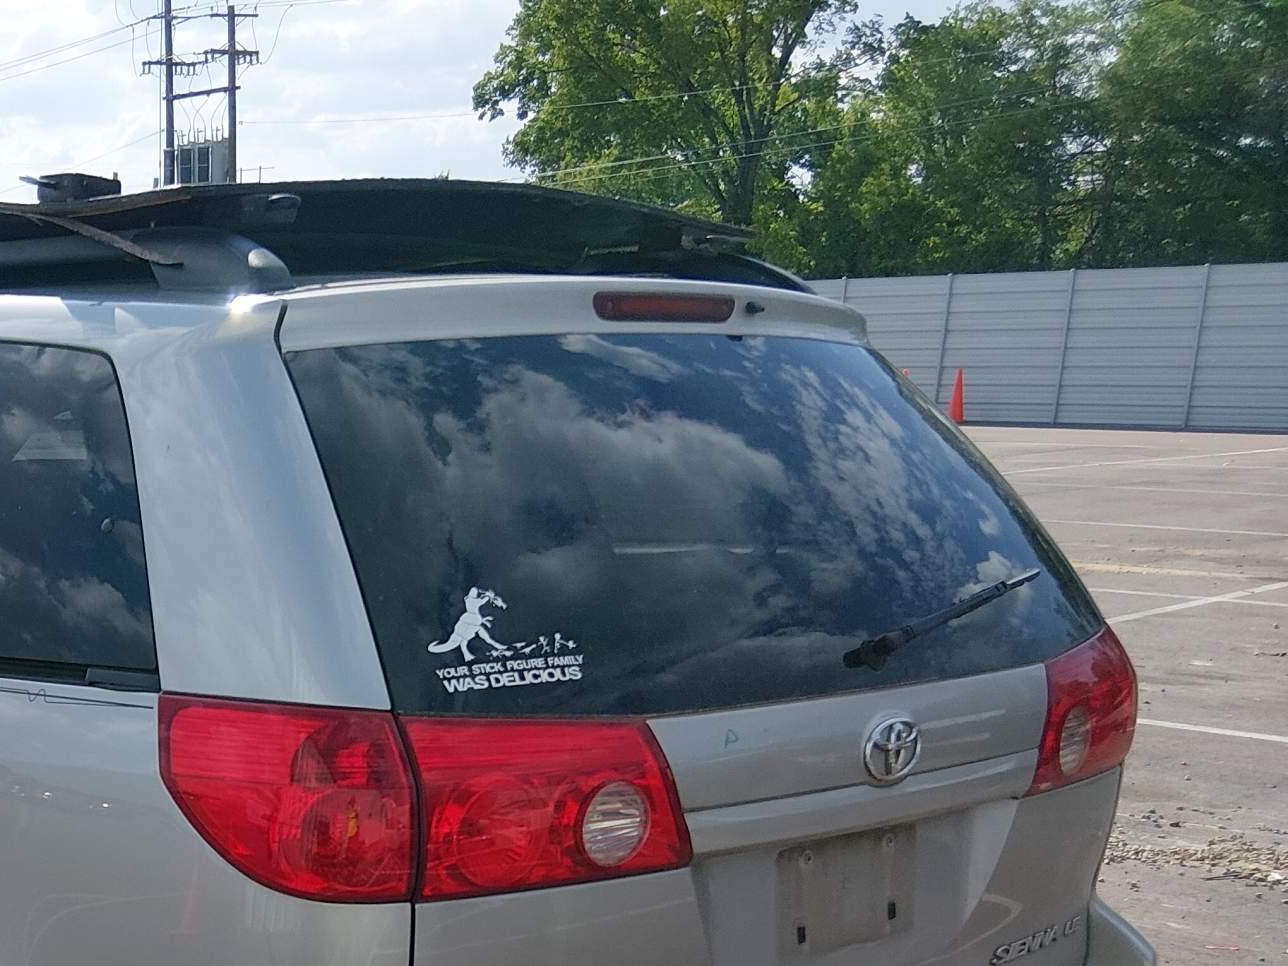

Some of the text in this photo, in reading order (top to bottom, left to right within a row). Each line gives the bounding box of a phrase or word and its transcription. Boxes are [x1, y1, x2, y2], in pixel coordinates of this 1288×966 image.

[435, 654, 584, 679] YOUR STICK FIGURE FAMILY
[443, 666, 582, 694] WAS DELICIOUS
